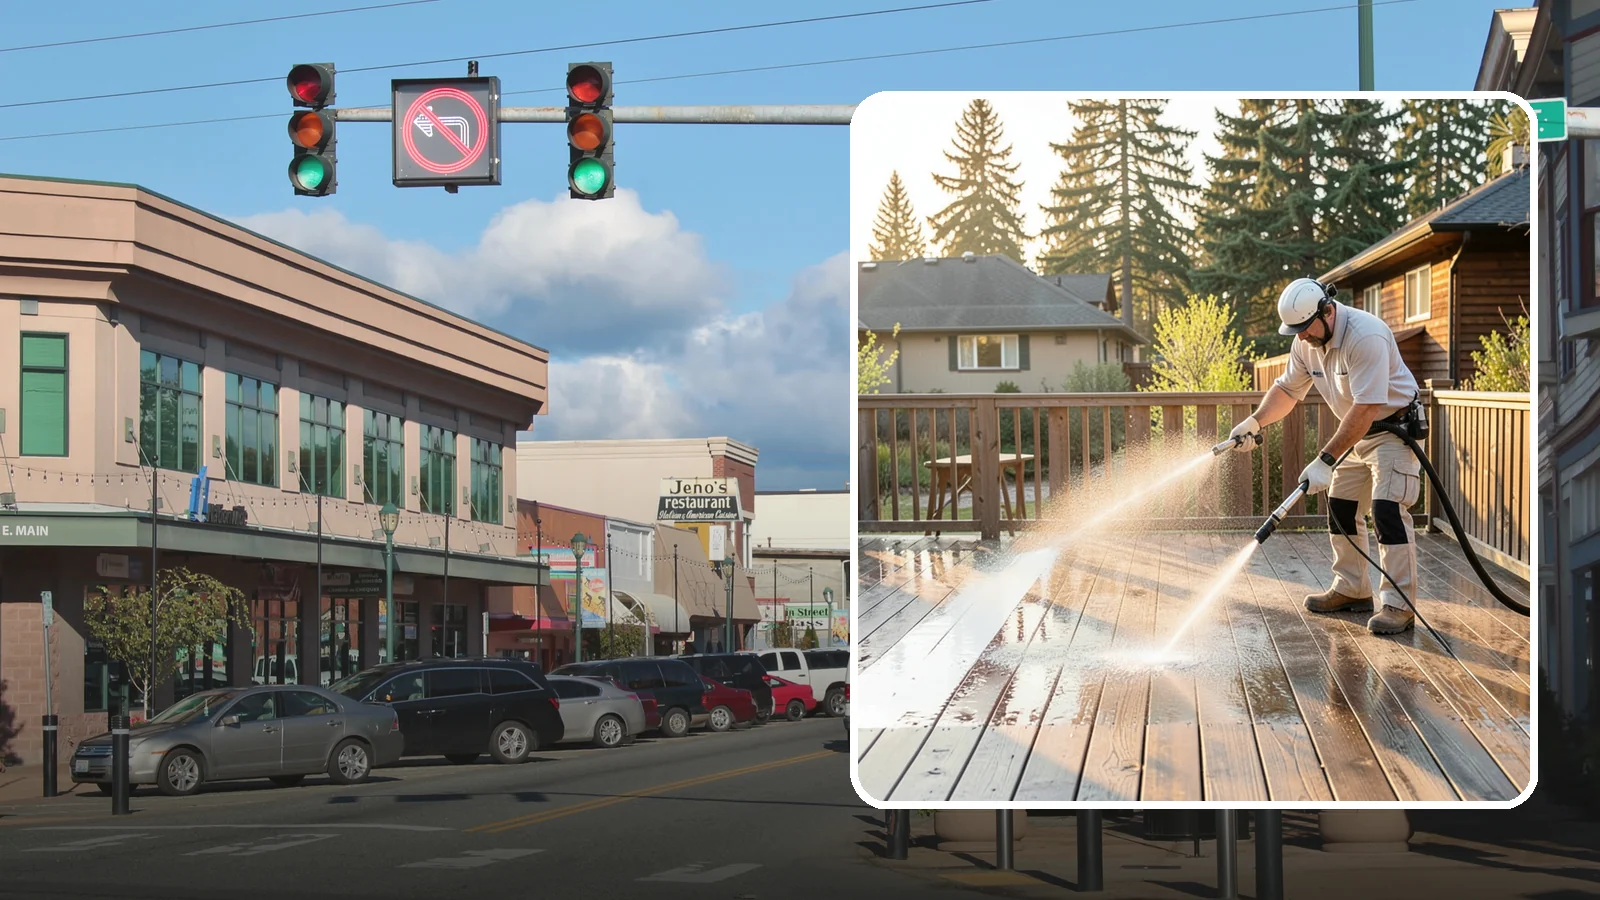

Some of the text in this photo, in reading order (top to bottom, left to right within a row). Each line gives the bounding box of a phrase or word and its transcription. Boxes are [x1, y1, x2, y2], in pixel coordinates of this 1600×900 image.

[670, 480, 727, 495] Jeno's
[665, 496, 731, 509] restaurant
[658, 510, 681, 520] Italian
[686, 510, 715, 519] American
[715, 509, 737, 519] Cuisine
[2, 525, 49, 536] E. MAIN
[797, 607, 829, 617] Street
